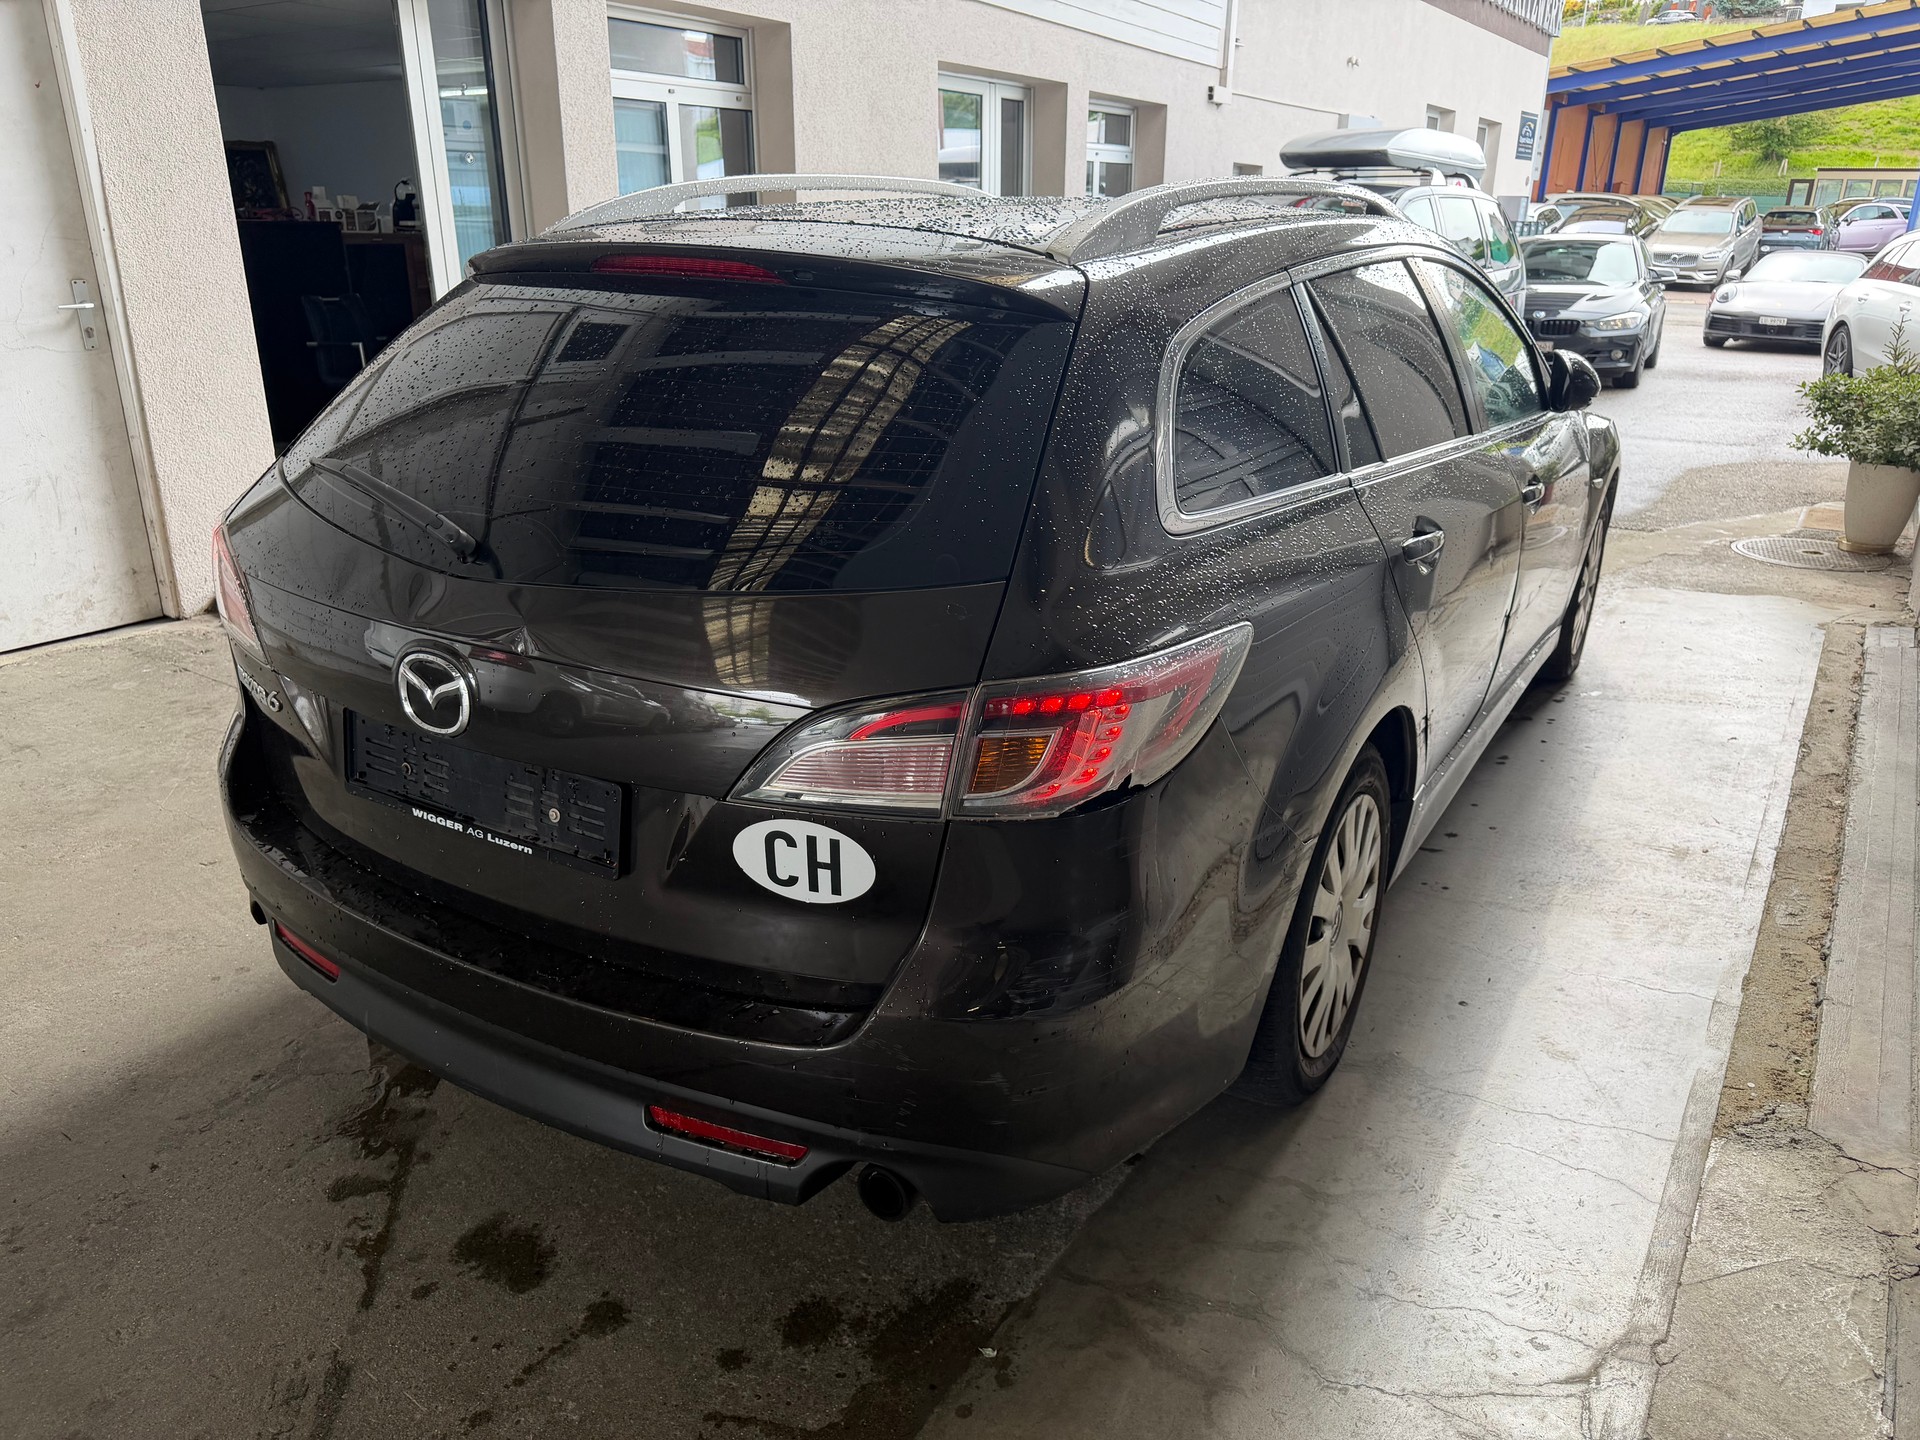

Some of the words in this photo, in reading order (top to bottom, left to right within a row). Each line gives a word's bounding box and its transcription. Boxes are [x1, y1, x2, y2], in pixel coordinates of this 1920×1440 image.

[411, 807, 463, 832] WIGGER
[466, 827, 484, 839] AG
[487, 833, 533, 855] Luzern
[764, 830, 842, 897] CH
